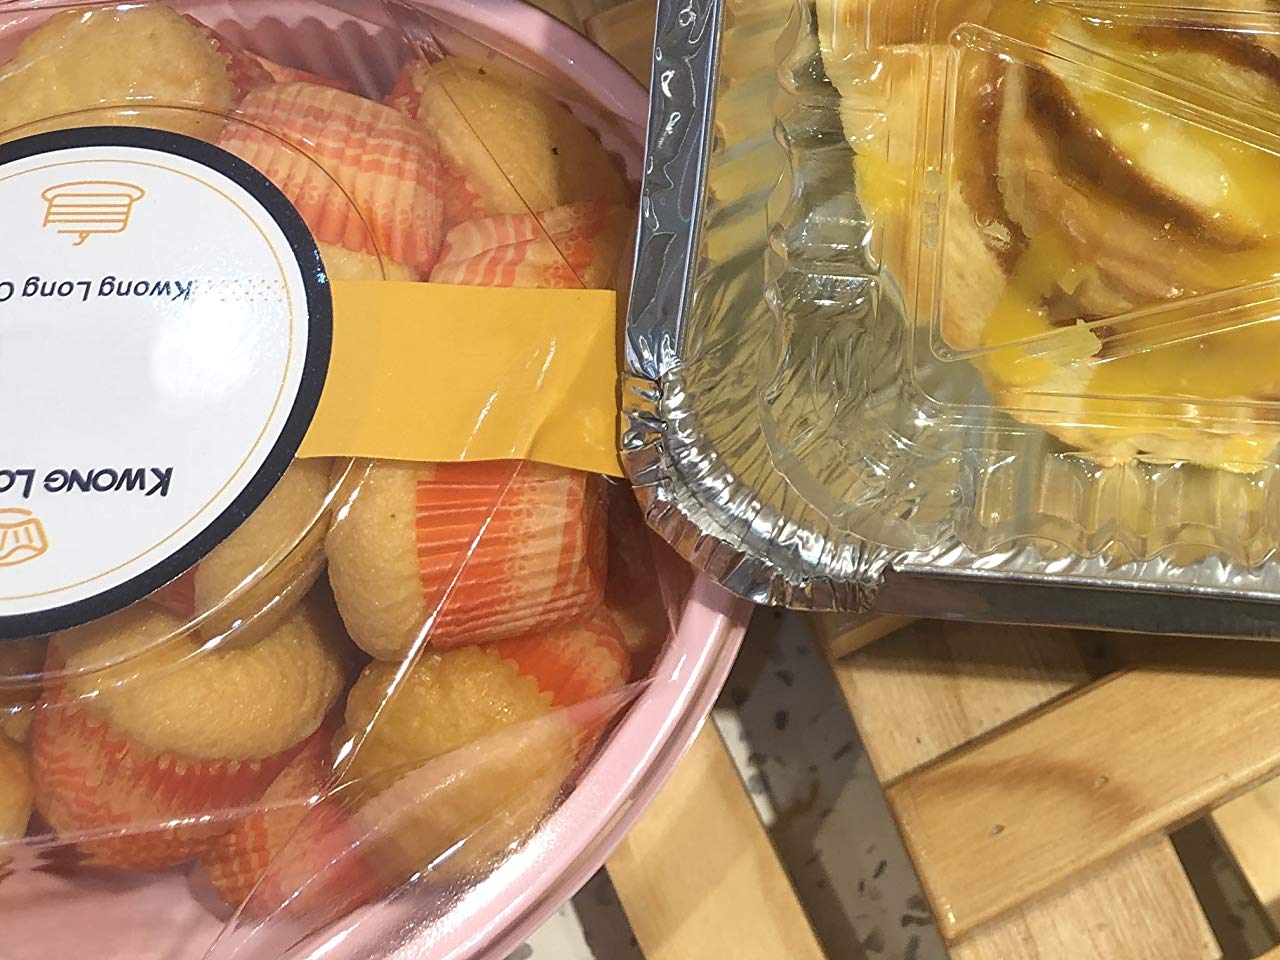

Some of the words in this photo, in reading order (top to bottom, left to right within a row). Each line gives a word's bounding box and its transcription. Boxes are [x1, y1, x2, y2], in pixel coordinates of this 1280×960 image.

[22, 276, 92, 302] Long
[98, 275, 193, 301] Kwong
[43, 467, 174, 497] KWONG
